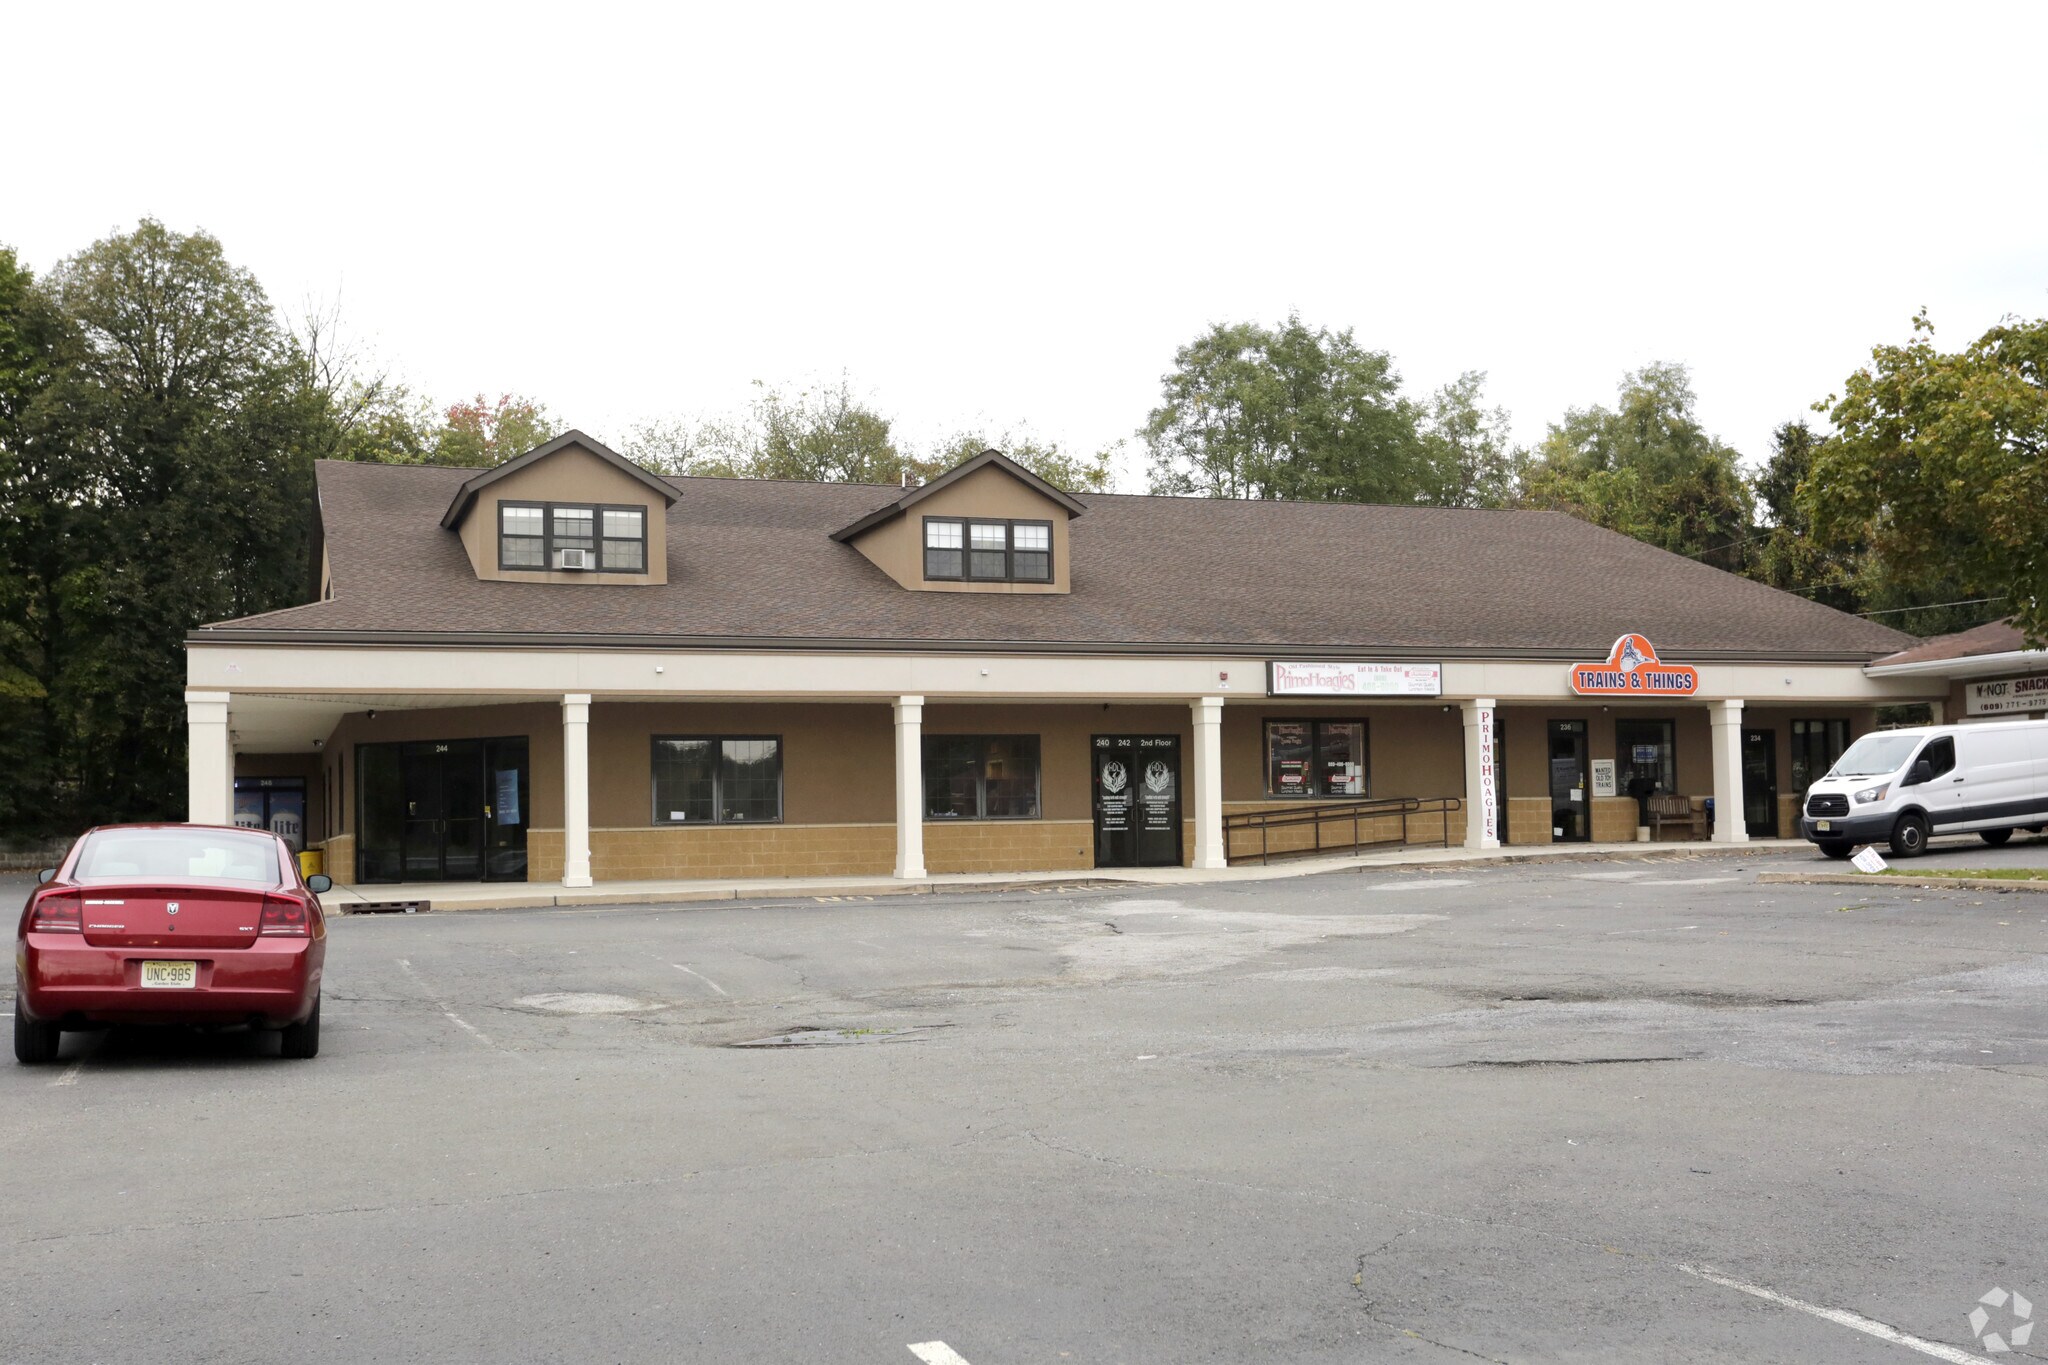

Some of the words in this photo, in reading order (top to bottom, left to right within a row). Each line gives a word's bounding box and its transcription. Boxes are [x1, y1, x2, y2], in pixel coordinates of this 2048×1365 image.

[1276, 664, 1355, 692] PrimoHoagies
[1579, 672, 1626, 688] TRAINS
[1631, 673, 1641, 688] &
[1645, 673, 1692, 689] THINGS
[1980, 702, 2003, 711] (609)
[1560, 723, 1571, 731] 236
[1096, 739, 1110, 747] 240
[1118, 739, 1131, 747] 242
[1140, 739, 1153, 747] 2nd
[1154, 739, 1172, 747] Floor
[274, 820, 299, 835] lite
